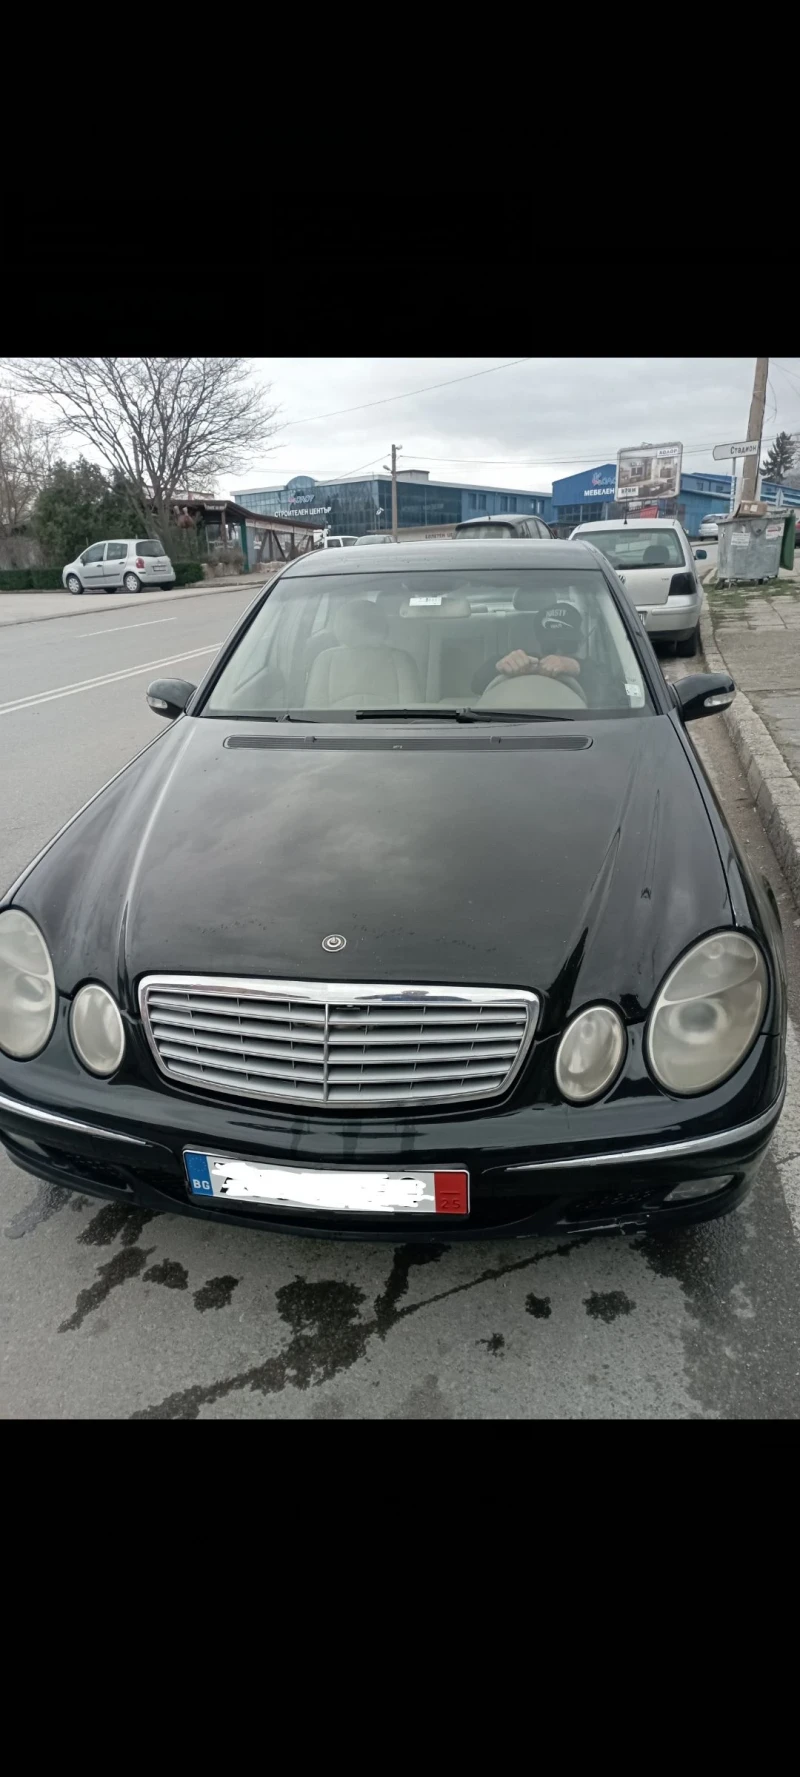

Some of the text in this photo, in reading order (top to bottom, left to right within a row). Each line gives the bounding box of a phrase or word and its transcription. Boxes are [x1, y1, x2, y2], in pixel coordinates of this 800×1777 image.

[730, 445, 757, 455] Стадион
[583, 487, 615, 497] МЕБЕЛЕН
[274, 506, 332, 518] СТРОИТЕЛЕН ЦЕНТЪР
[192, 1178, 211, 1190] BG
[440, 1197, 461, 1209] 25
